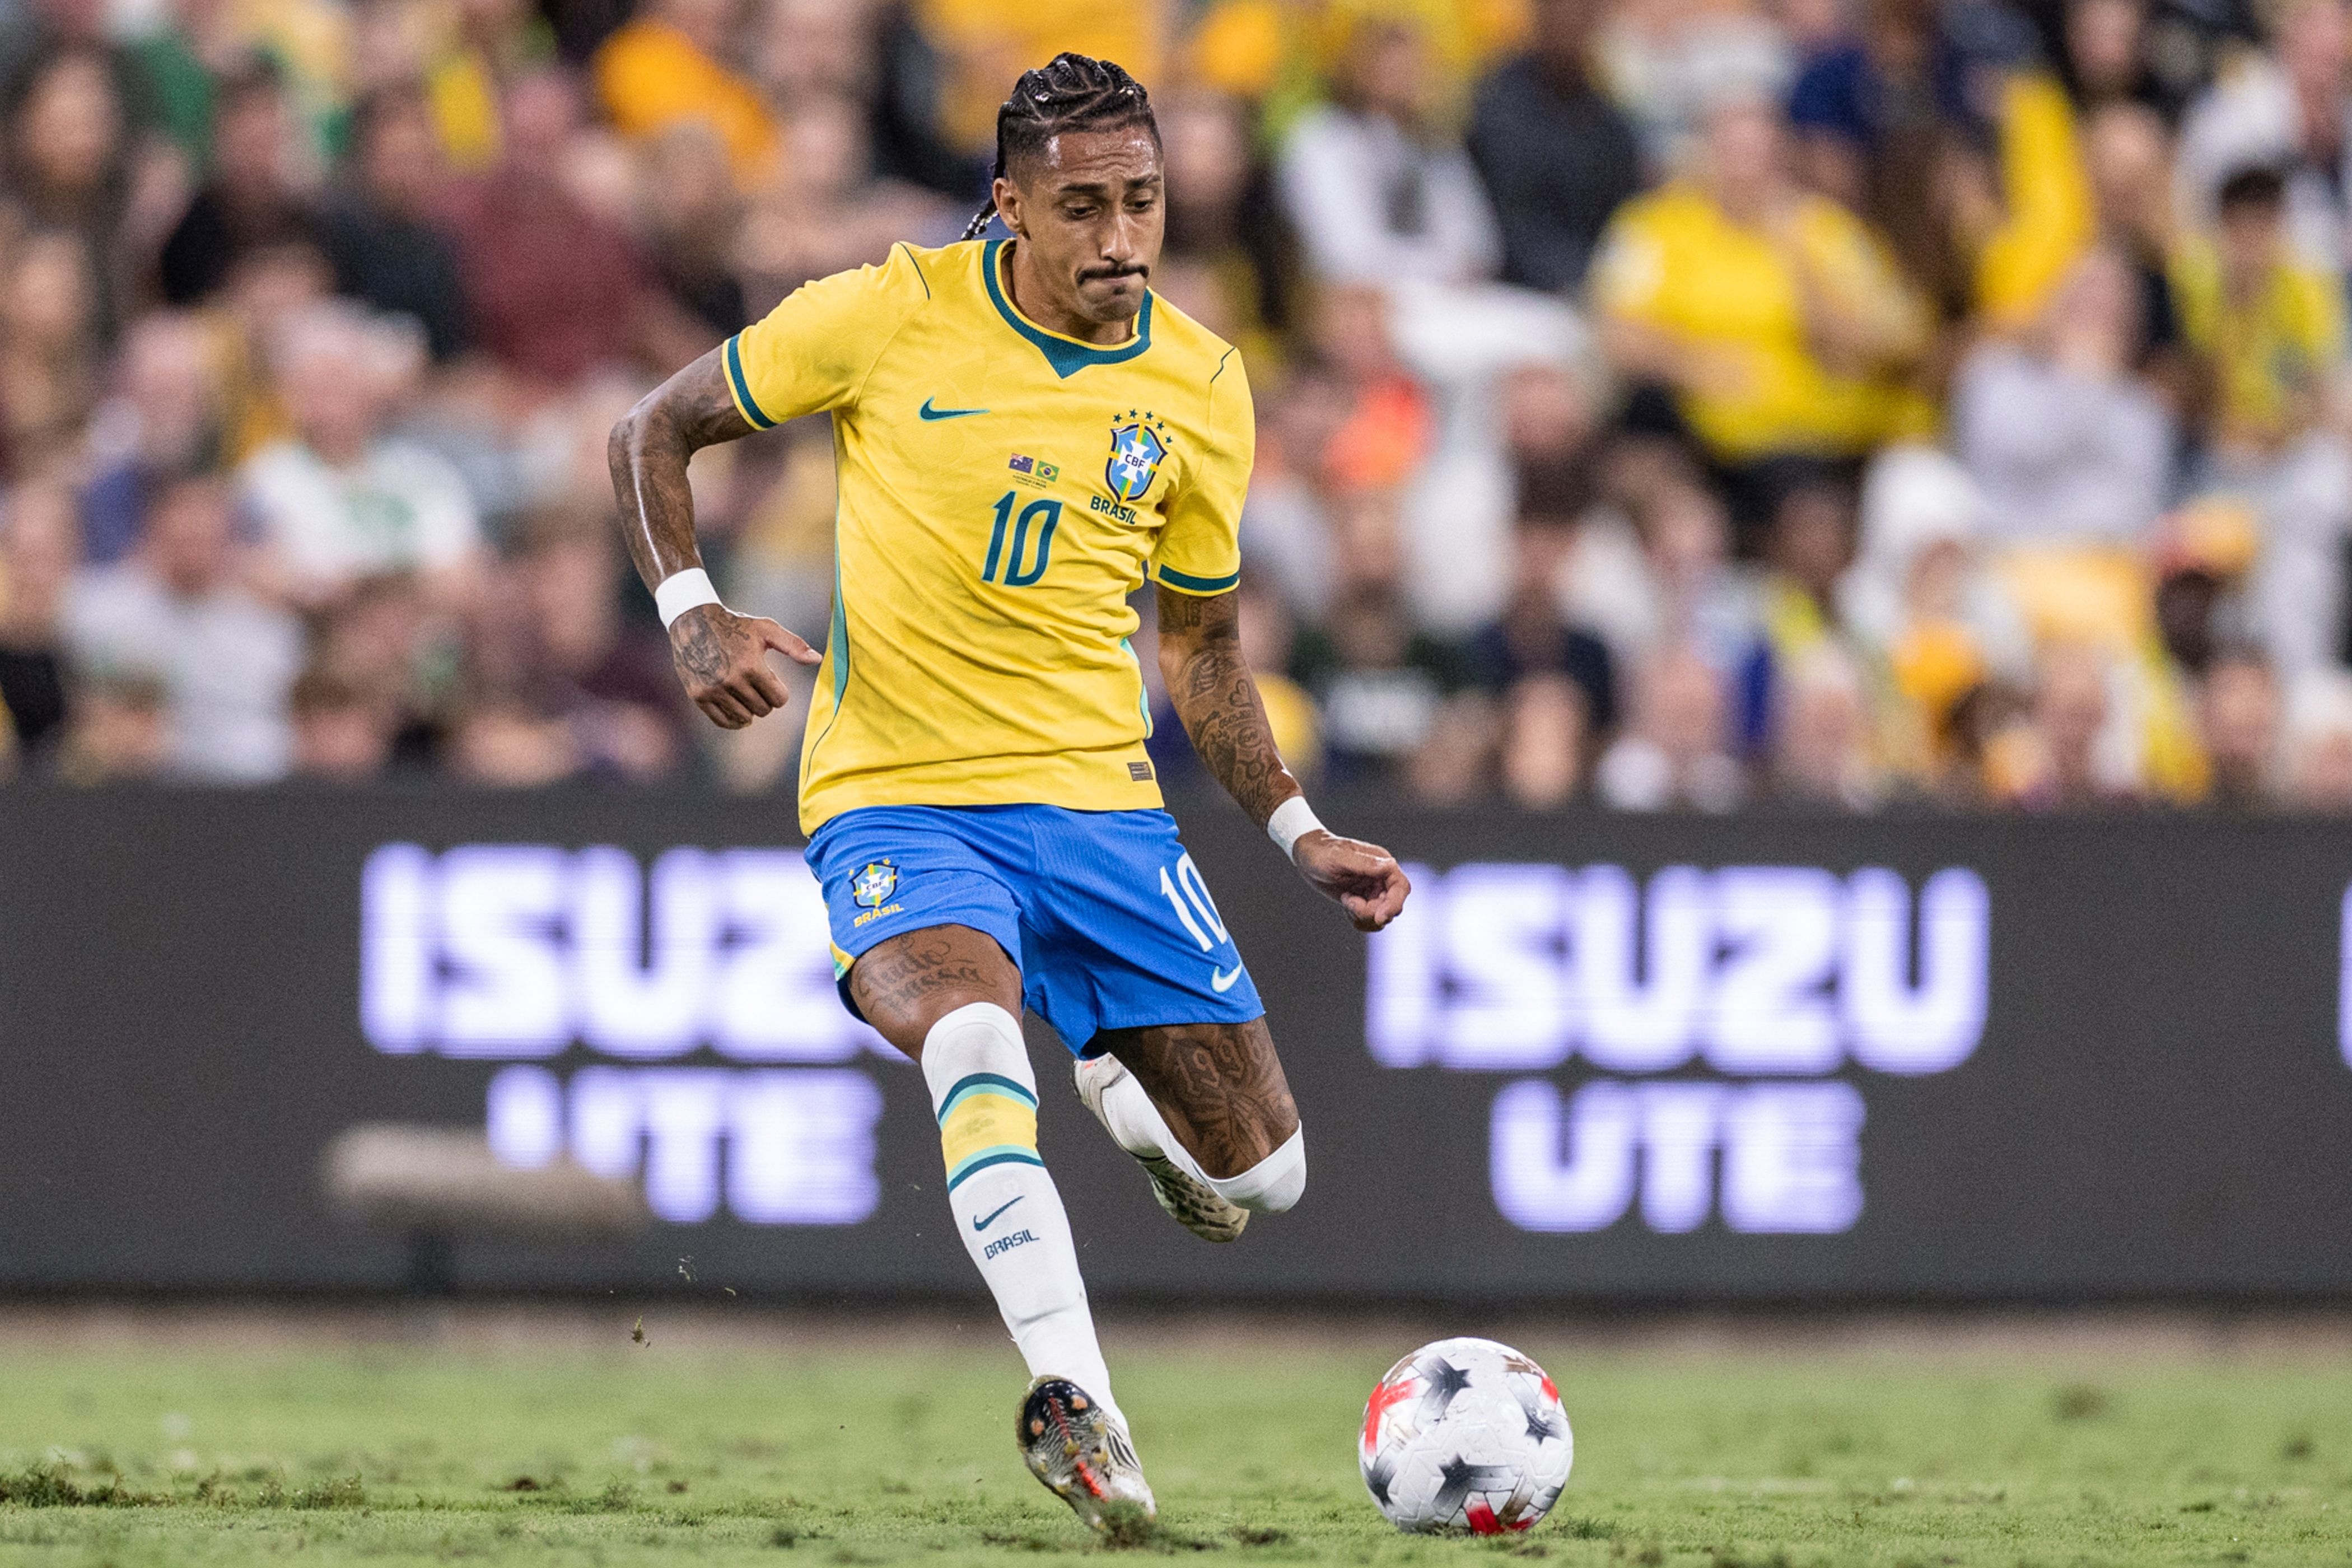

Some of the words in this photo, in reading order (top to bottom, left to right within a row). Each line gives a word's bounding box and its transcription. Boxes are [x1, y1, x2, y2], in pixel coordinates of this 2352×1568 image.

[1124, 454, 1146, 469] CBF
[981, 491, 1063, 587] 10
[1090, 496, 1137, 525] BRASIL
[853, 903, 905, 928] BRASIL
[1159, 851, 1228, 953] 10
[359, 841, 918, 1064] ISUZ
[1364, 861, 1991, 1077] ISUZU
[1488, 1077, 1868, 1234] UTE
[983, 1229, 1040, 1260] BRASIL
